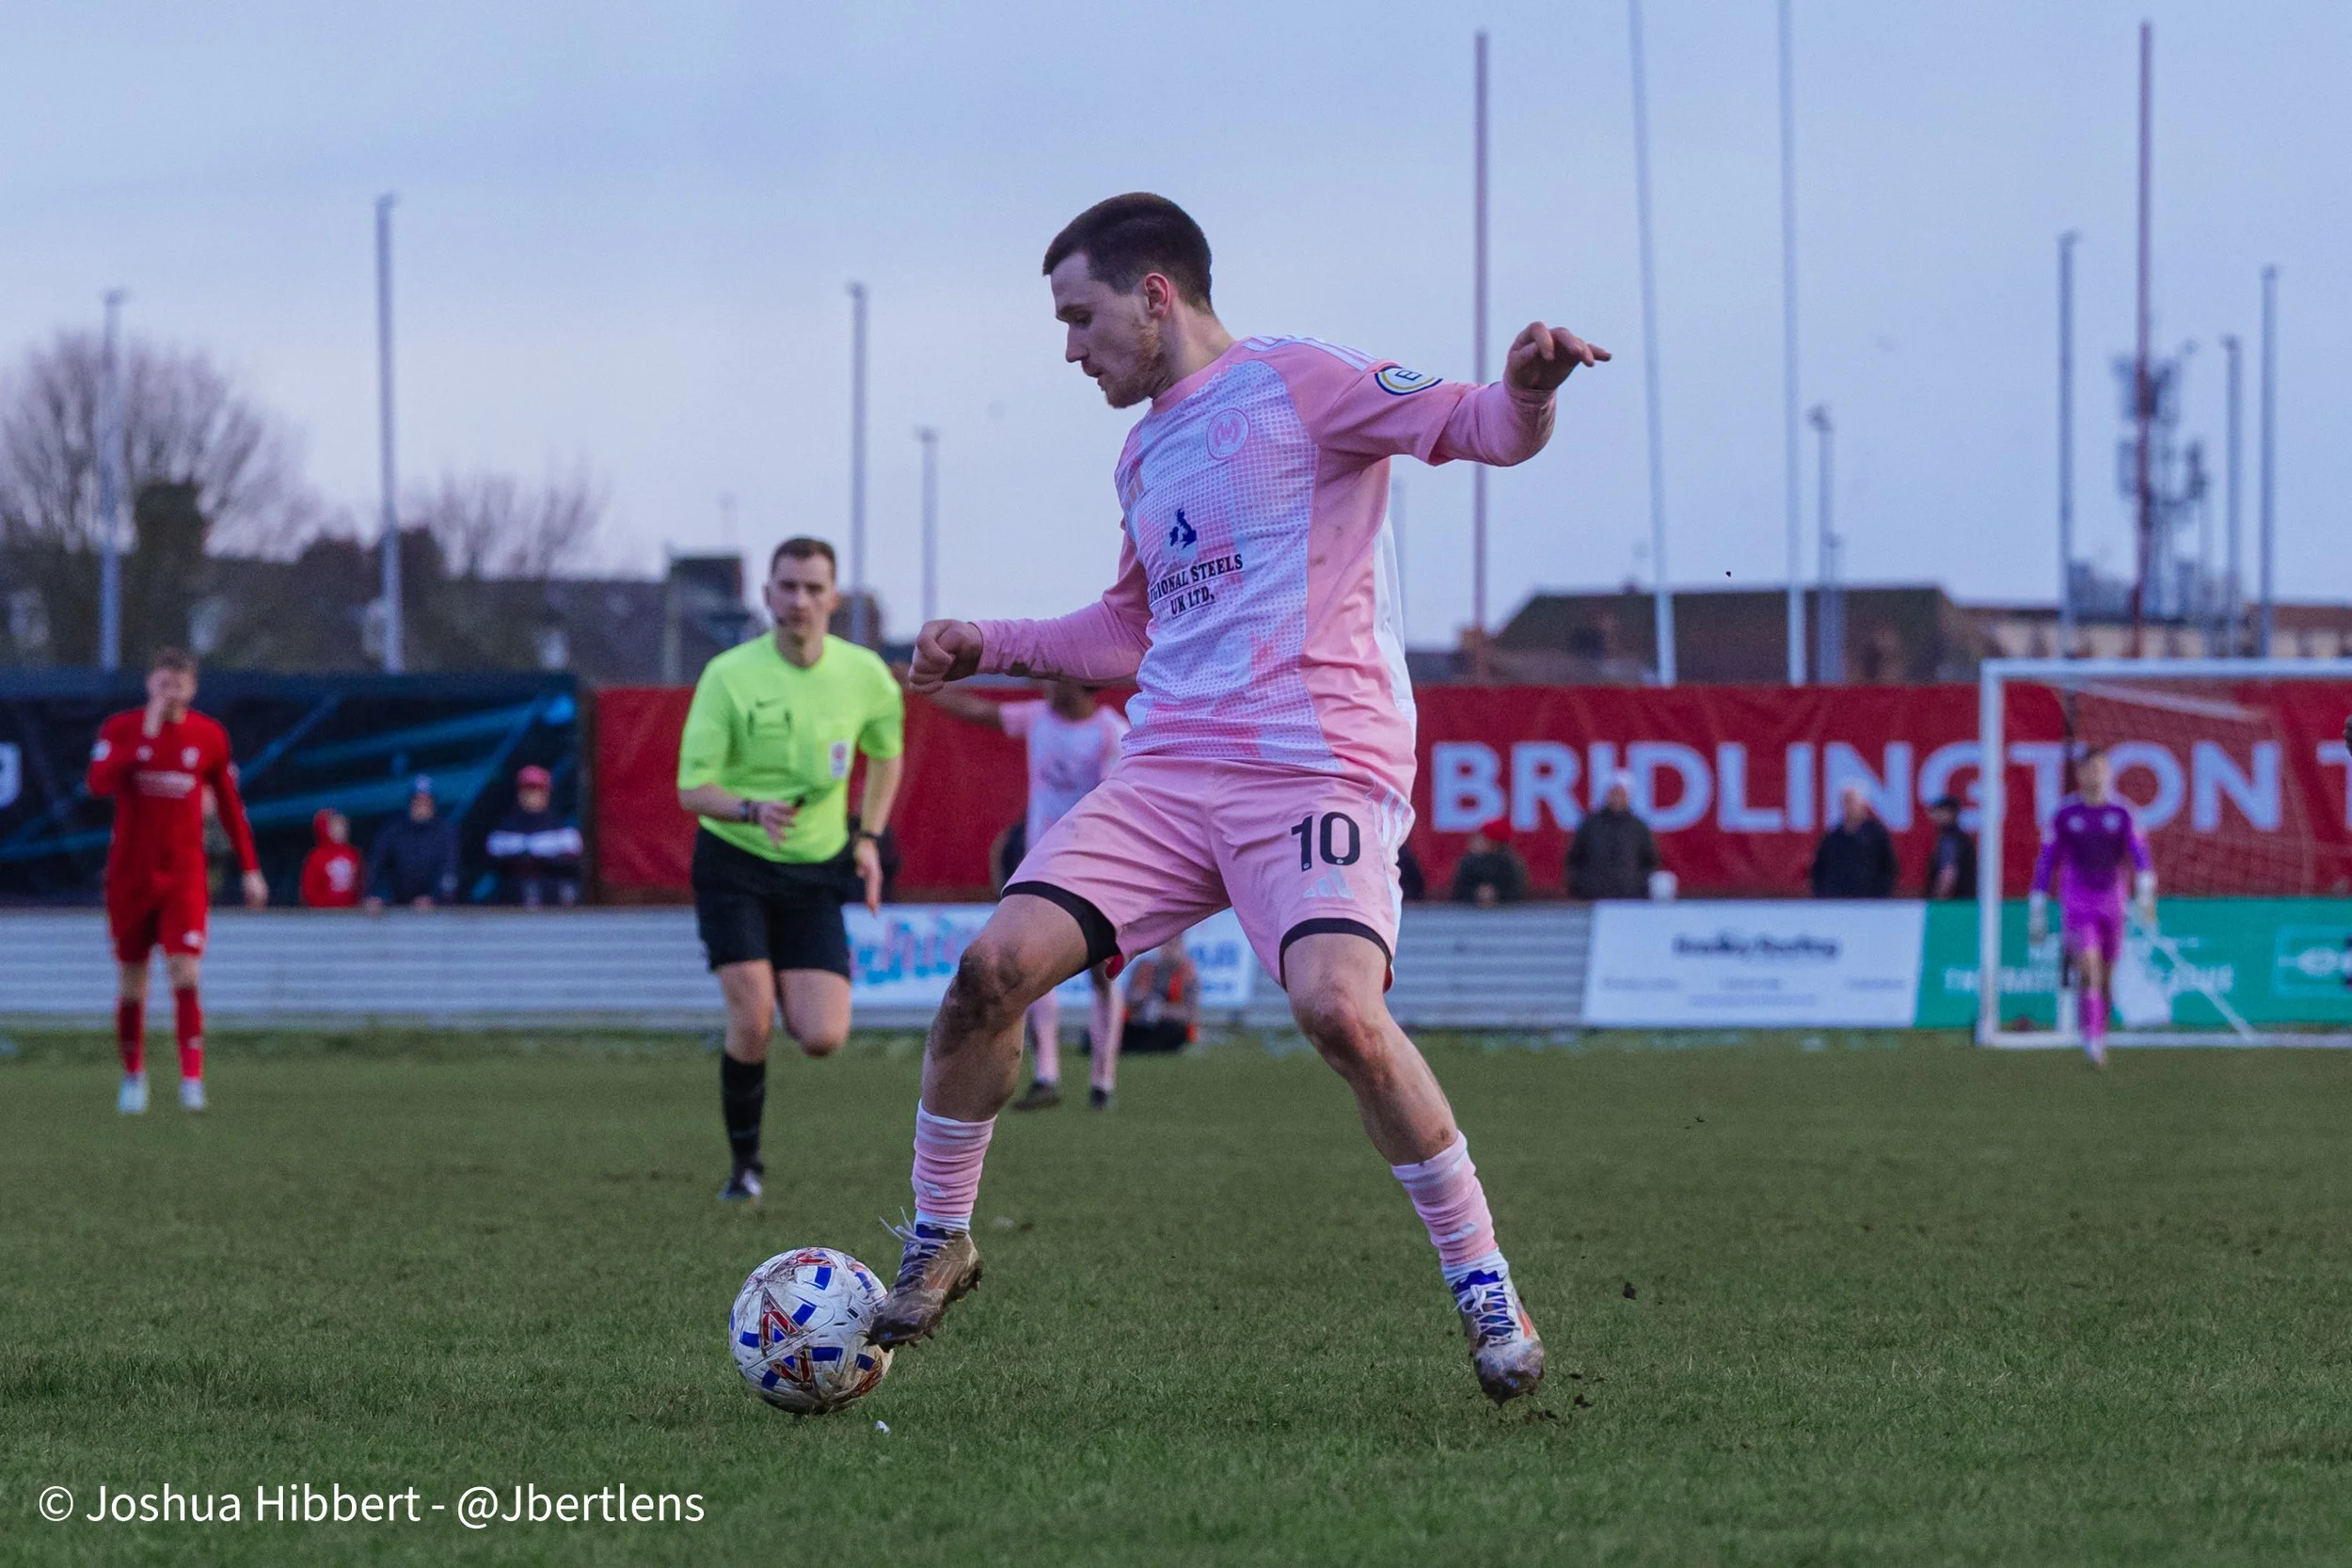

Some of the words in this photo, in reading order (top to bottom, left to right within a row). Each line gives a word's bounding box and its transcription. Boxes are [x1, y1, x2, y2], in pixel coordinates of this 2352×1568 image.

[1149, 571, 1188, 603] EGIONAL
[1190, 553, 1243, 582] STEELS
[1170, 594, 1186, 615] UK
[1432, 740, 2282, 832] BRIDLINGTON
[1291, 812, 1360, 872] 10
